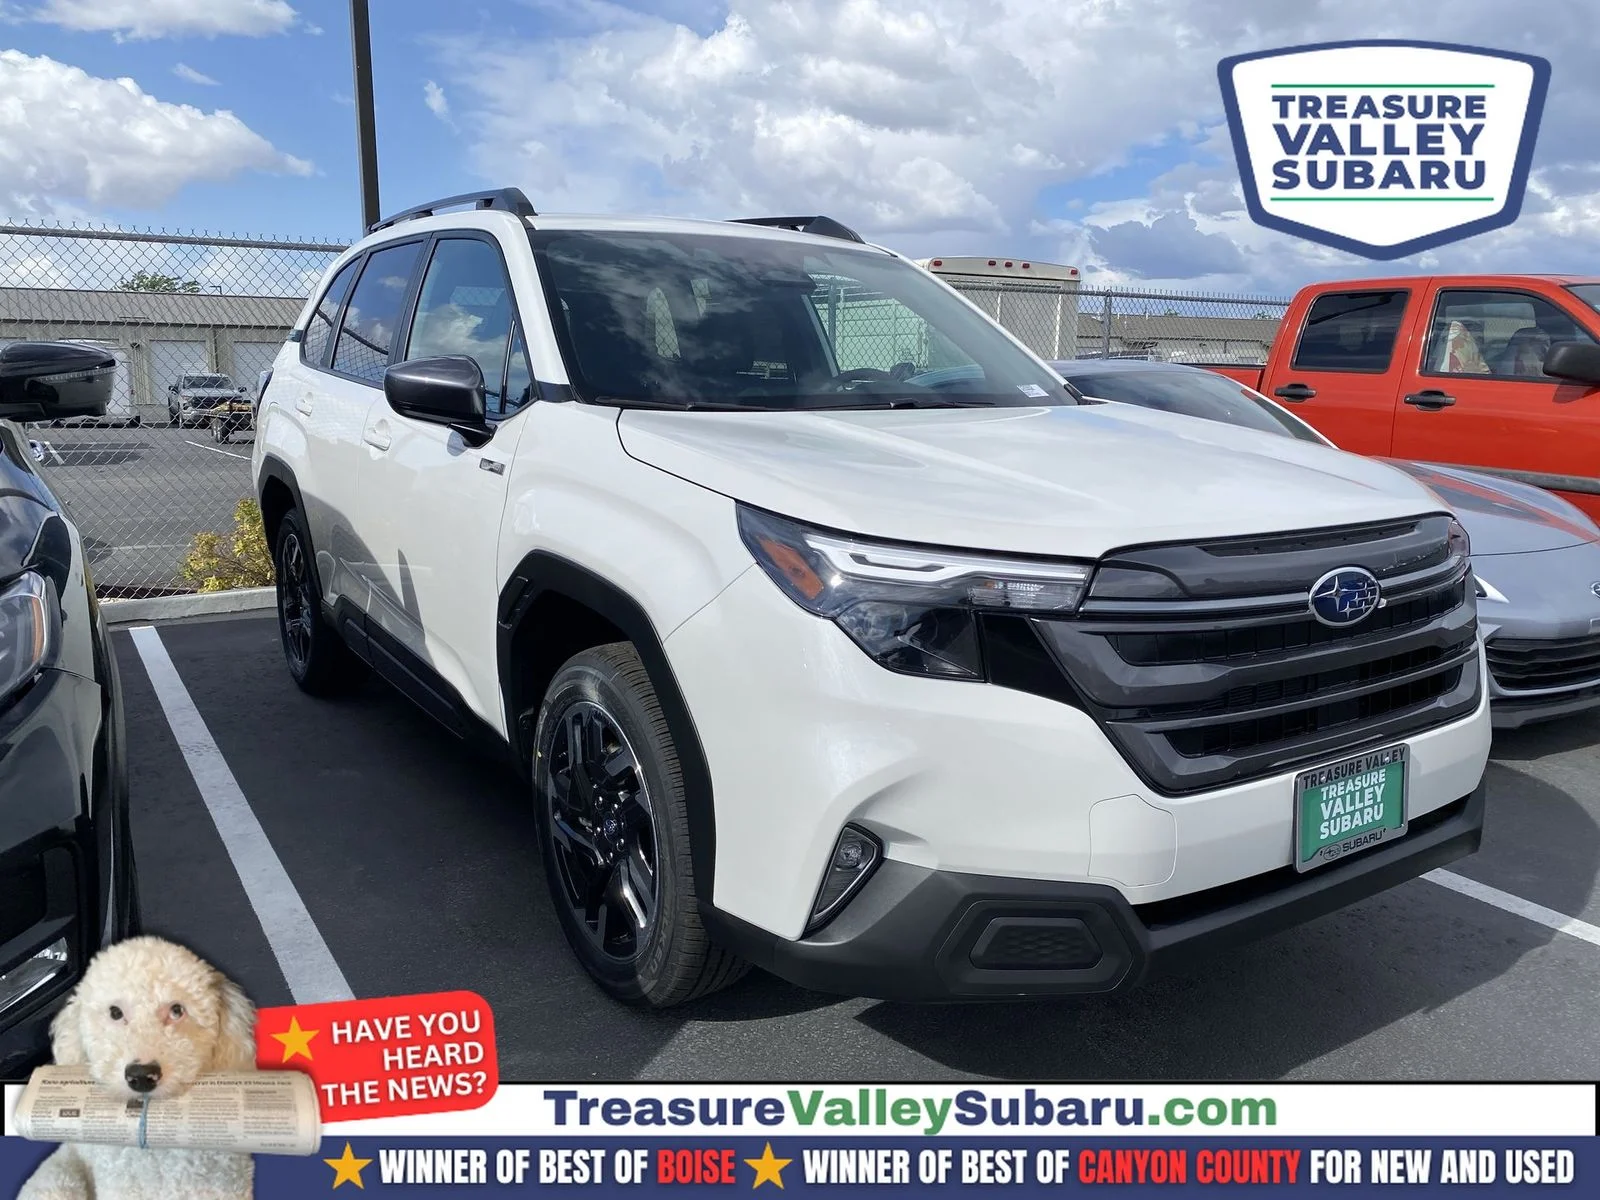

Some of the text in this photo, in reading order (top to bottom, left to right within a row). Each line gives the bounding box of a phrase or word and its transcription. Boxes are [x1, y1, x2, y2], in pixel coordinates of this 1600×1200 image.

[1303, 747, 1406, 789] TREASURE VALLEY
[1321, 769, 1386, 801] TREASURE
[1320, 783, 1386, 820] VALLEY
[1319, 803, 1384, 840] SUBARU
[1342, 829, 1383, 853] SUBARU
